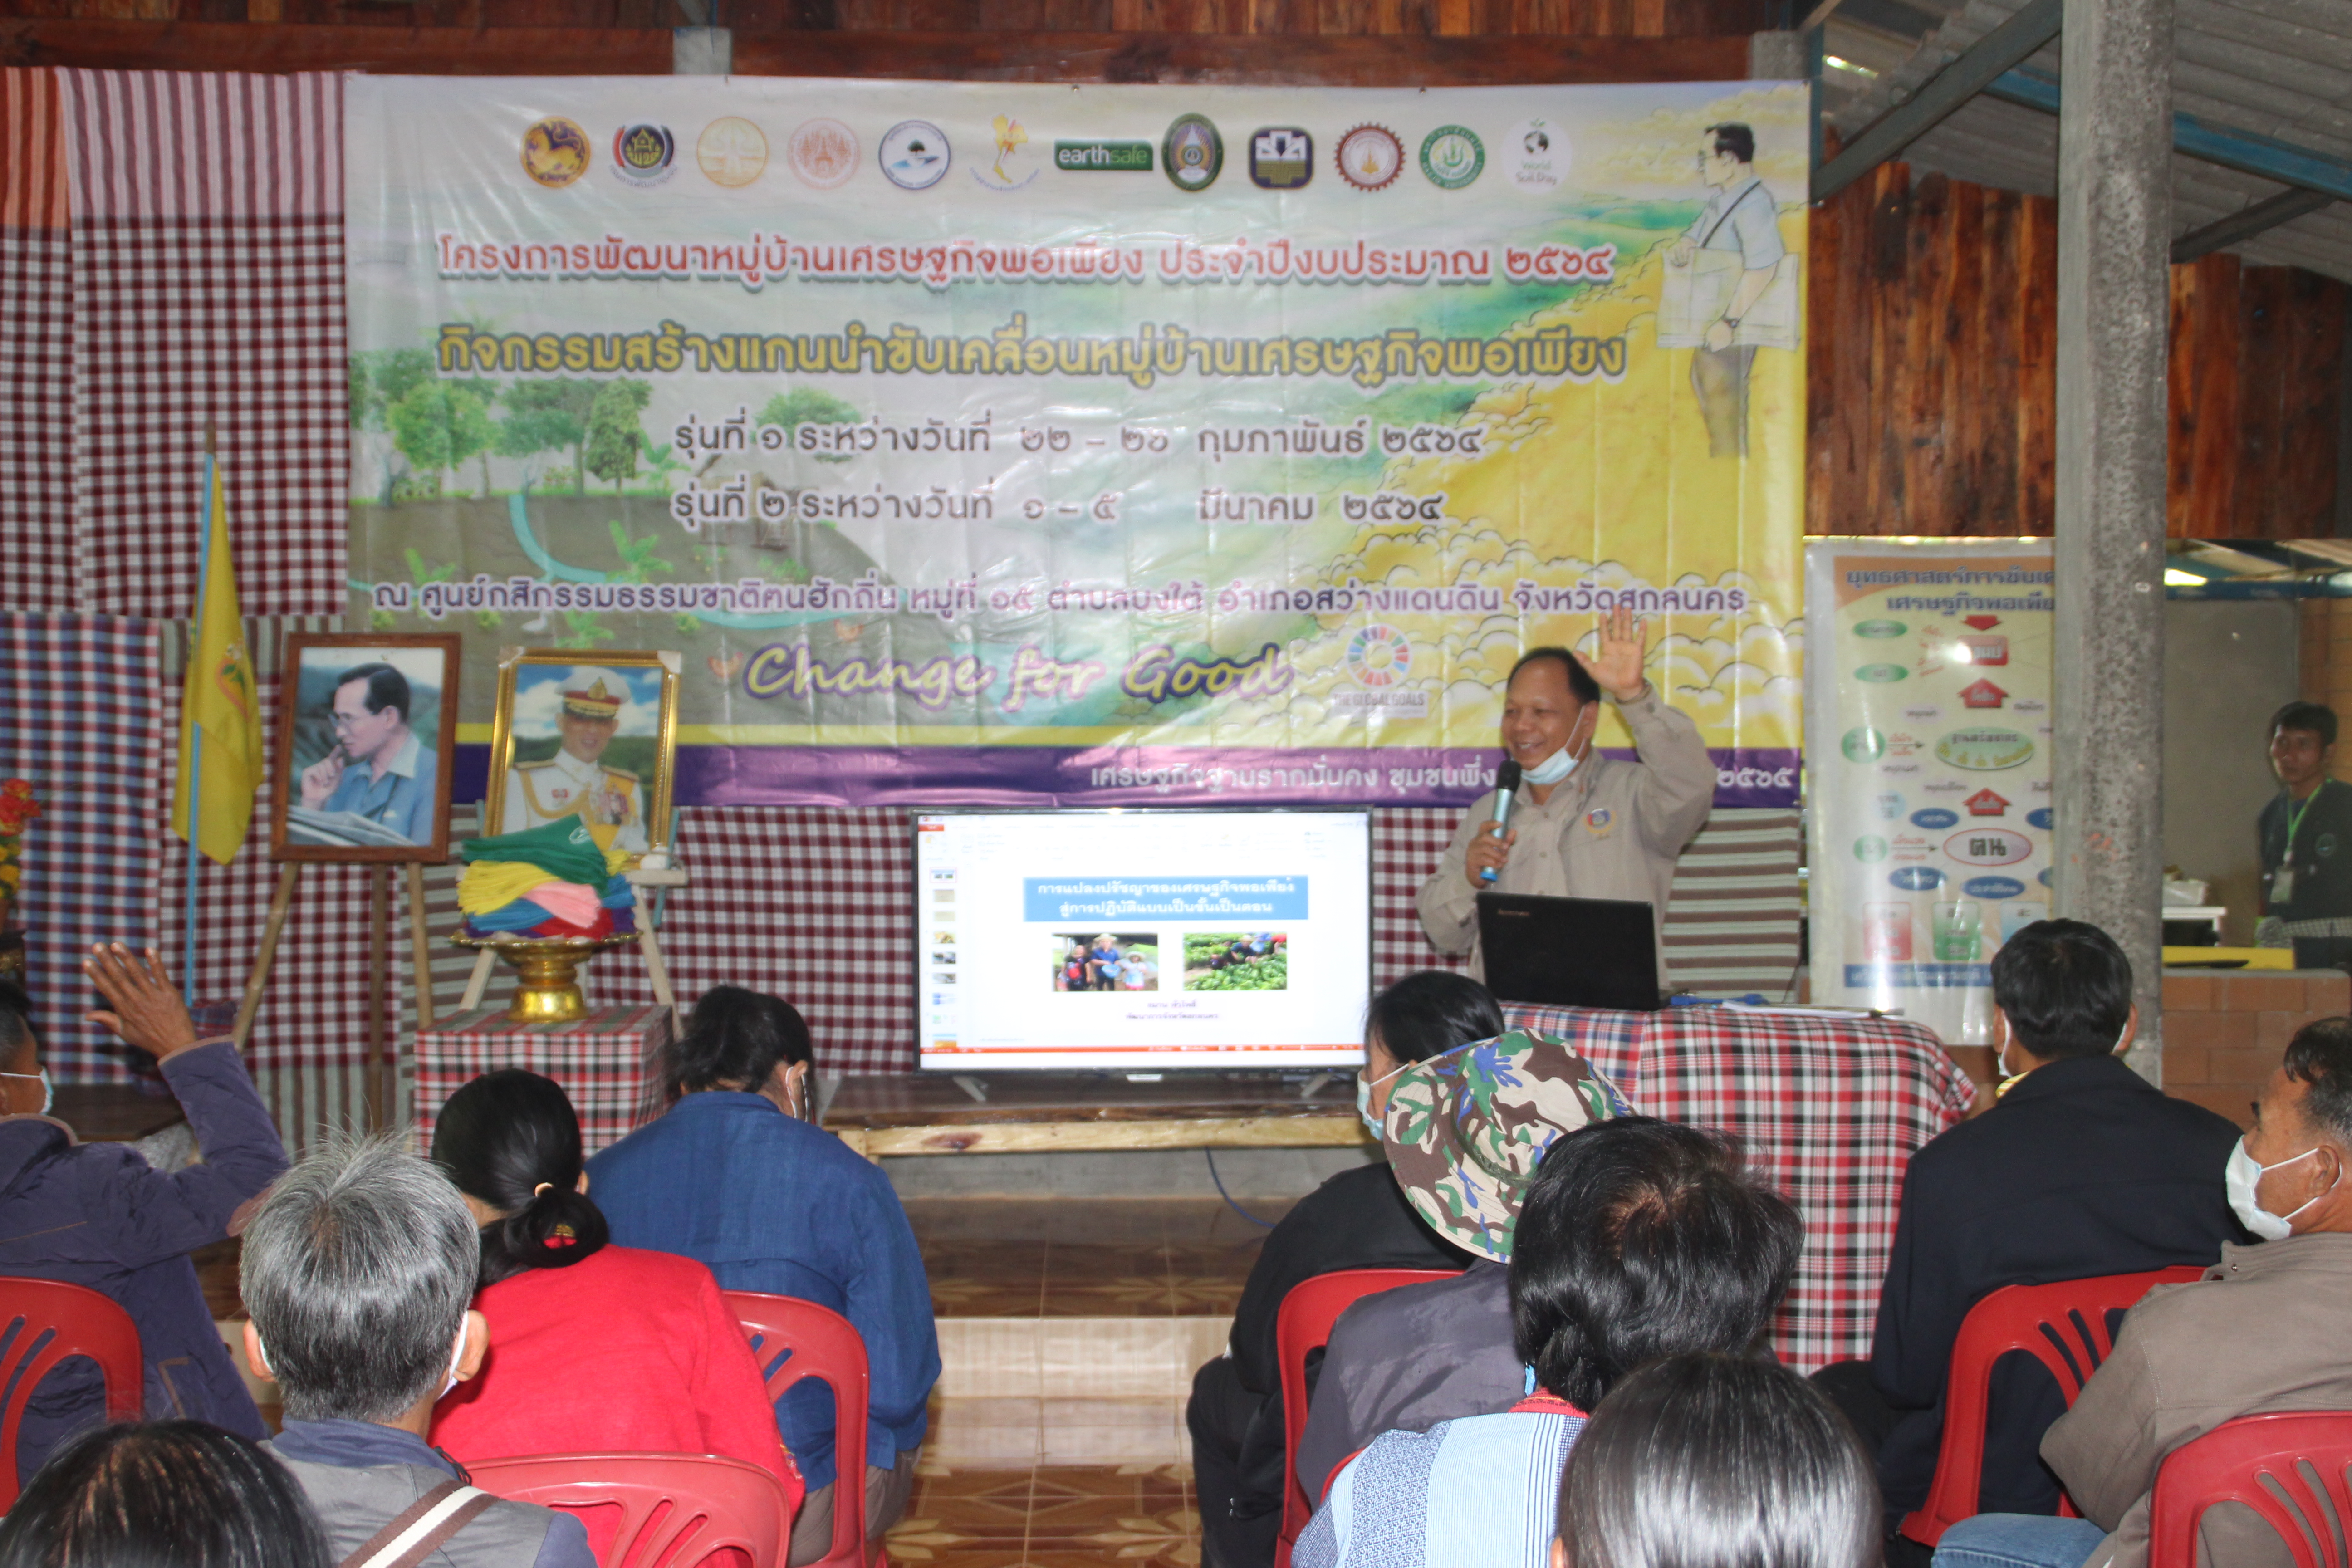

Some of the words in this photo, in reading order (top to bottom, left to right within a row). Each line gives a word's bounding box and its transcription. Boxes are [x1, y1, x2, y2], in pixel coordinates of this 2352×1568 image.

[1058, 143, 1148, 164] earthsafe
[440, 233, 1142, 282] โครงการพัฒนาหมู่บ้านเศรษฐกิจพอเพียง
[1160, 239, 1488, 274] ประจำปีงบประมาณ
[1507, 245, 1611, 275] ๒๕๖๔
[439, 312, 1624, 385] กิจกรรมสร้างแกนนำขับเคลื่อนหมู่บ้านเศรษฐกิจพอเพียง
[675, 407, 745, 458] รุ่นที่
[799, 410, 991, 452] ระหว่างวันที่
[1021, 426, 1070, 451] ๒๒
[1121, 426, 1168, 452] ๒๖
[1197, 418, 1367, 461] กุมภาพันธ์
[1383, 426, 1483, 453] ๒๕๖๔
[675, 474, 745, 527] รุ่นที่
[801, 476, 992, 519] ระหว่างวันที่
[1199, 487, 1313, 520] มีนาคม
[1343, 494, 1442, 521] ๒๕๖๔
[375, 585, 406, 608] ณ
[911, 572, 975, 617] หมู่ที่
[1219, 579, 1499, 610] อำเภอสว่างแดนดิน
[1515, 581, 1744, 610] จังหวัดสกลนคร
[744, 643, 996, 710] Change
[1002, 643, 1105, 712] for
[1122, 643, 1294, 704] Good
[1333, 693, 1351, 705] THE
[1353, 693, 1390, 705] GLOBAL
[1392, 693, 1425, 705] GOALS
[1091, 754, 1377, 793] เศรษฐกิจฐานรากมั่นคง
